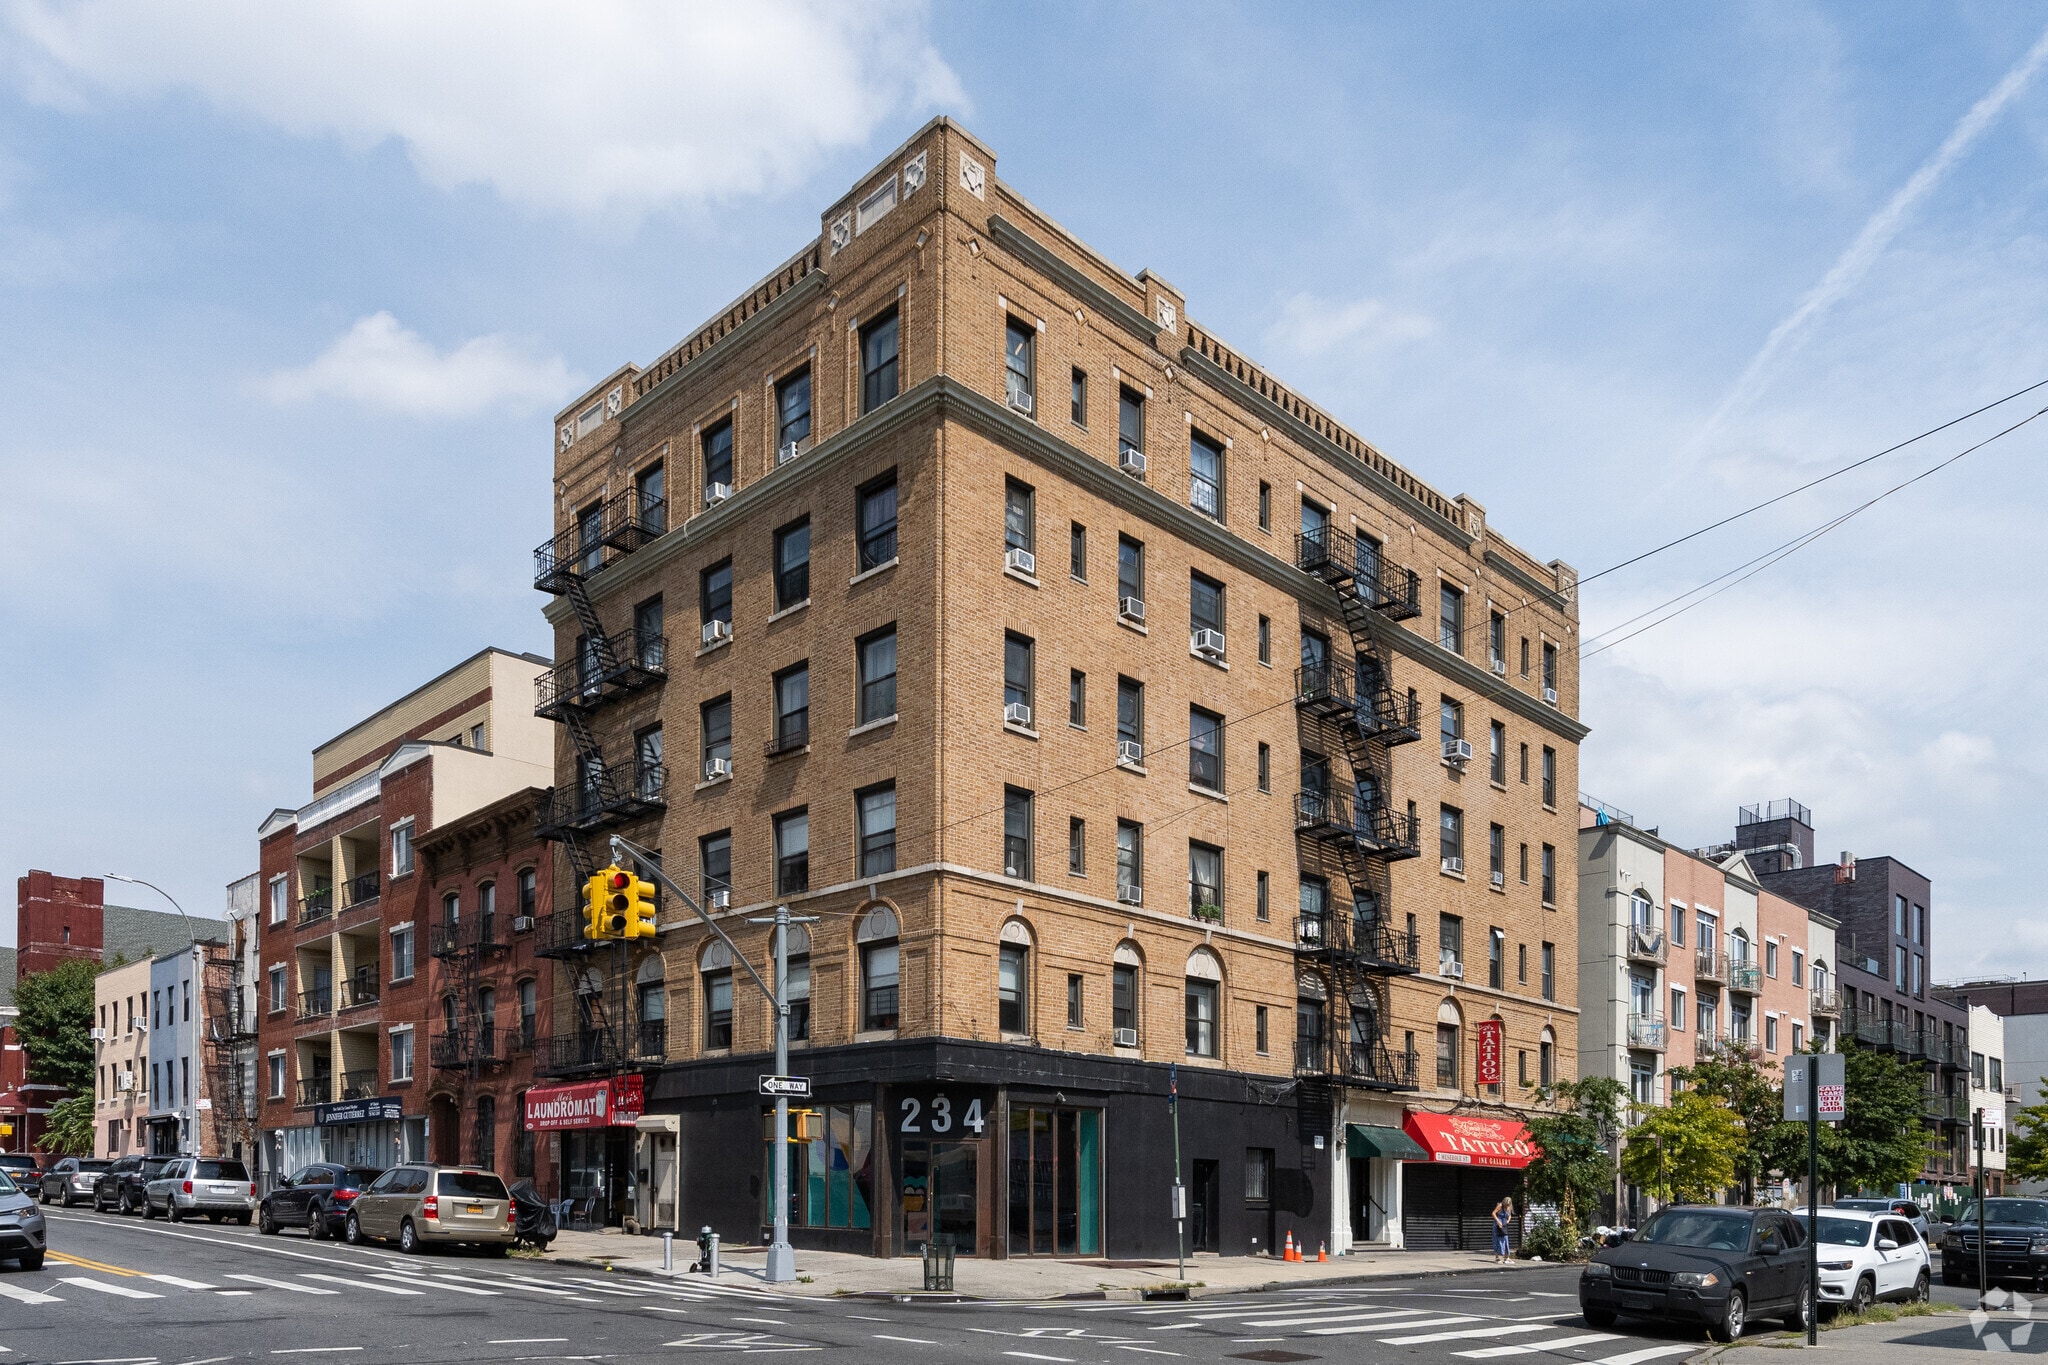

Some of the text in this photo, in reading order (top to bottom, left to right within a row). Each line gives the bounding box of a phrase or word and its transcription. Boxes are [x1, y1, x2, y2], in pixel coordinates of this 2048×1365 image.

[1482, 1030, 1496, 1075] TATTOO
[768, 1081, 804, 1090] ONE WAY
[528, 1097, 597, 1119] LAUNDROMAT
[901, 1097, 985, 1133] 234
[563, 1118, 573, 1126] SELF
[573, 1116, 590, 1125] SERVICE
[1439, 1131, 1530, 1157] TATTOO
[1489, 1158, 1511, 1166] GALLERY
